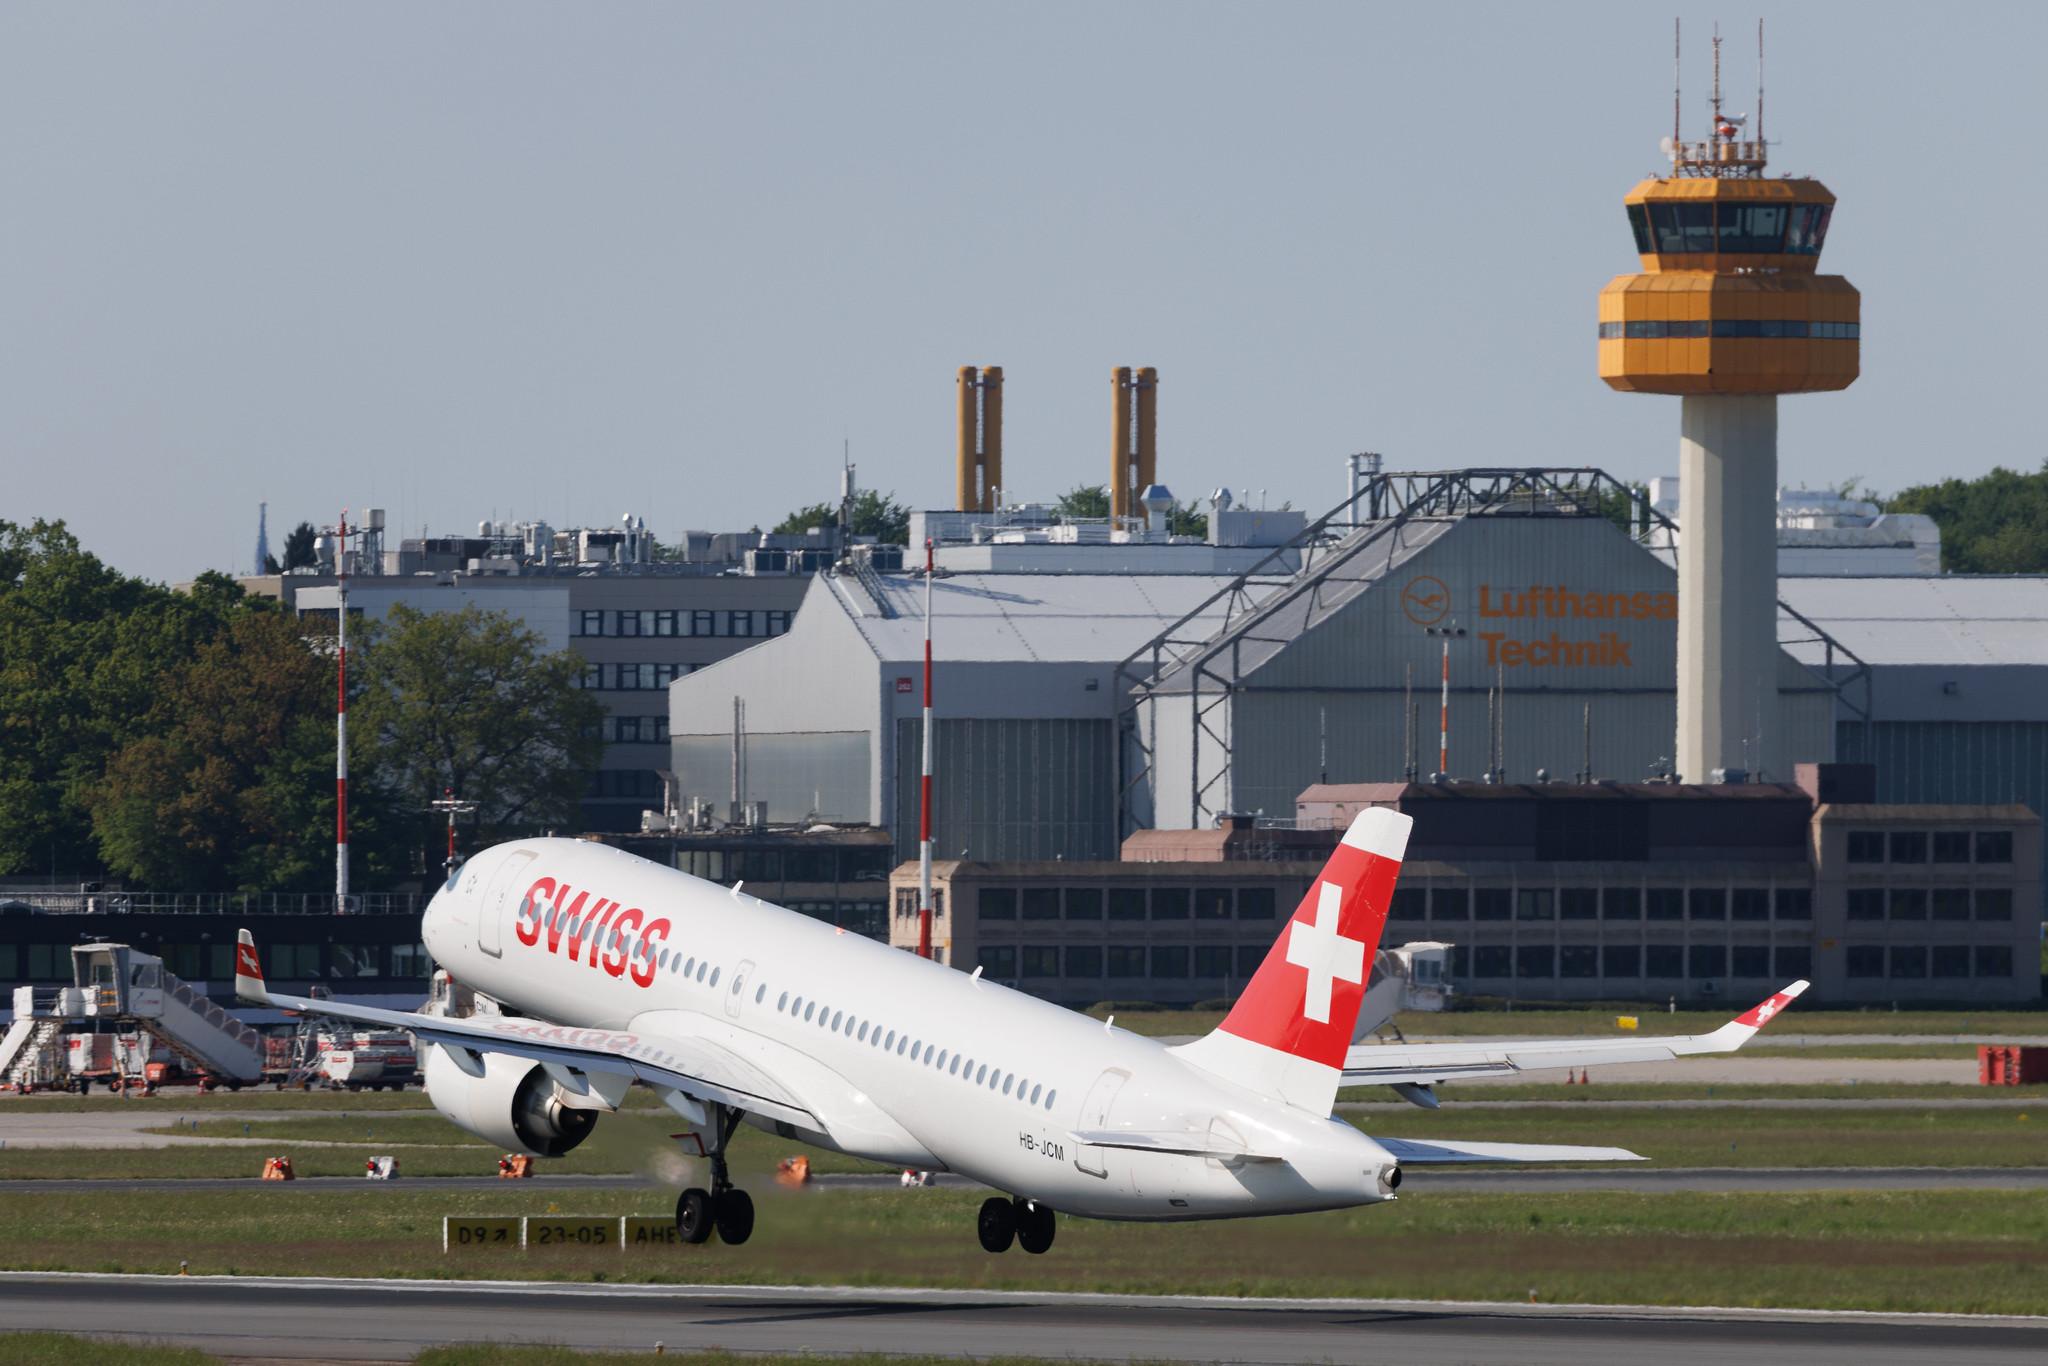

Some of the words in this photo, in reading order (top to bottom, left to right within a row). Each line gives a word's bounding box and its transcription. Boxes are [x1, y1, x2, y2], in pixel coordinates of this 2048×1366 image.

[1479, 584, 1677, 619] Lufthansa
[1478, 632, 1632, 668] Technik
[516, 877, 671, 988] SWISS
[1019, 1132, 1064, 1161] HB-JCM
[458, 1227, 488, 1244] D9
[538, 1226, 607, 1244] 23-05
[635, 1226, 687, 1244] AHE
